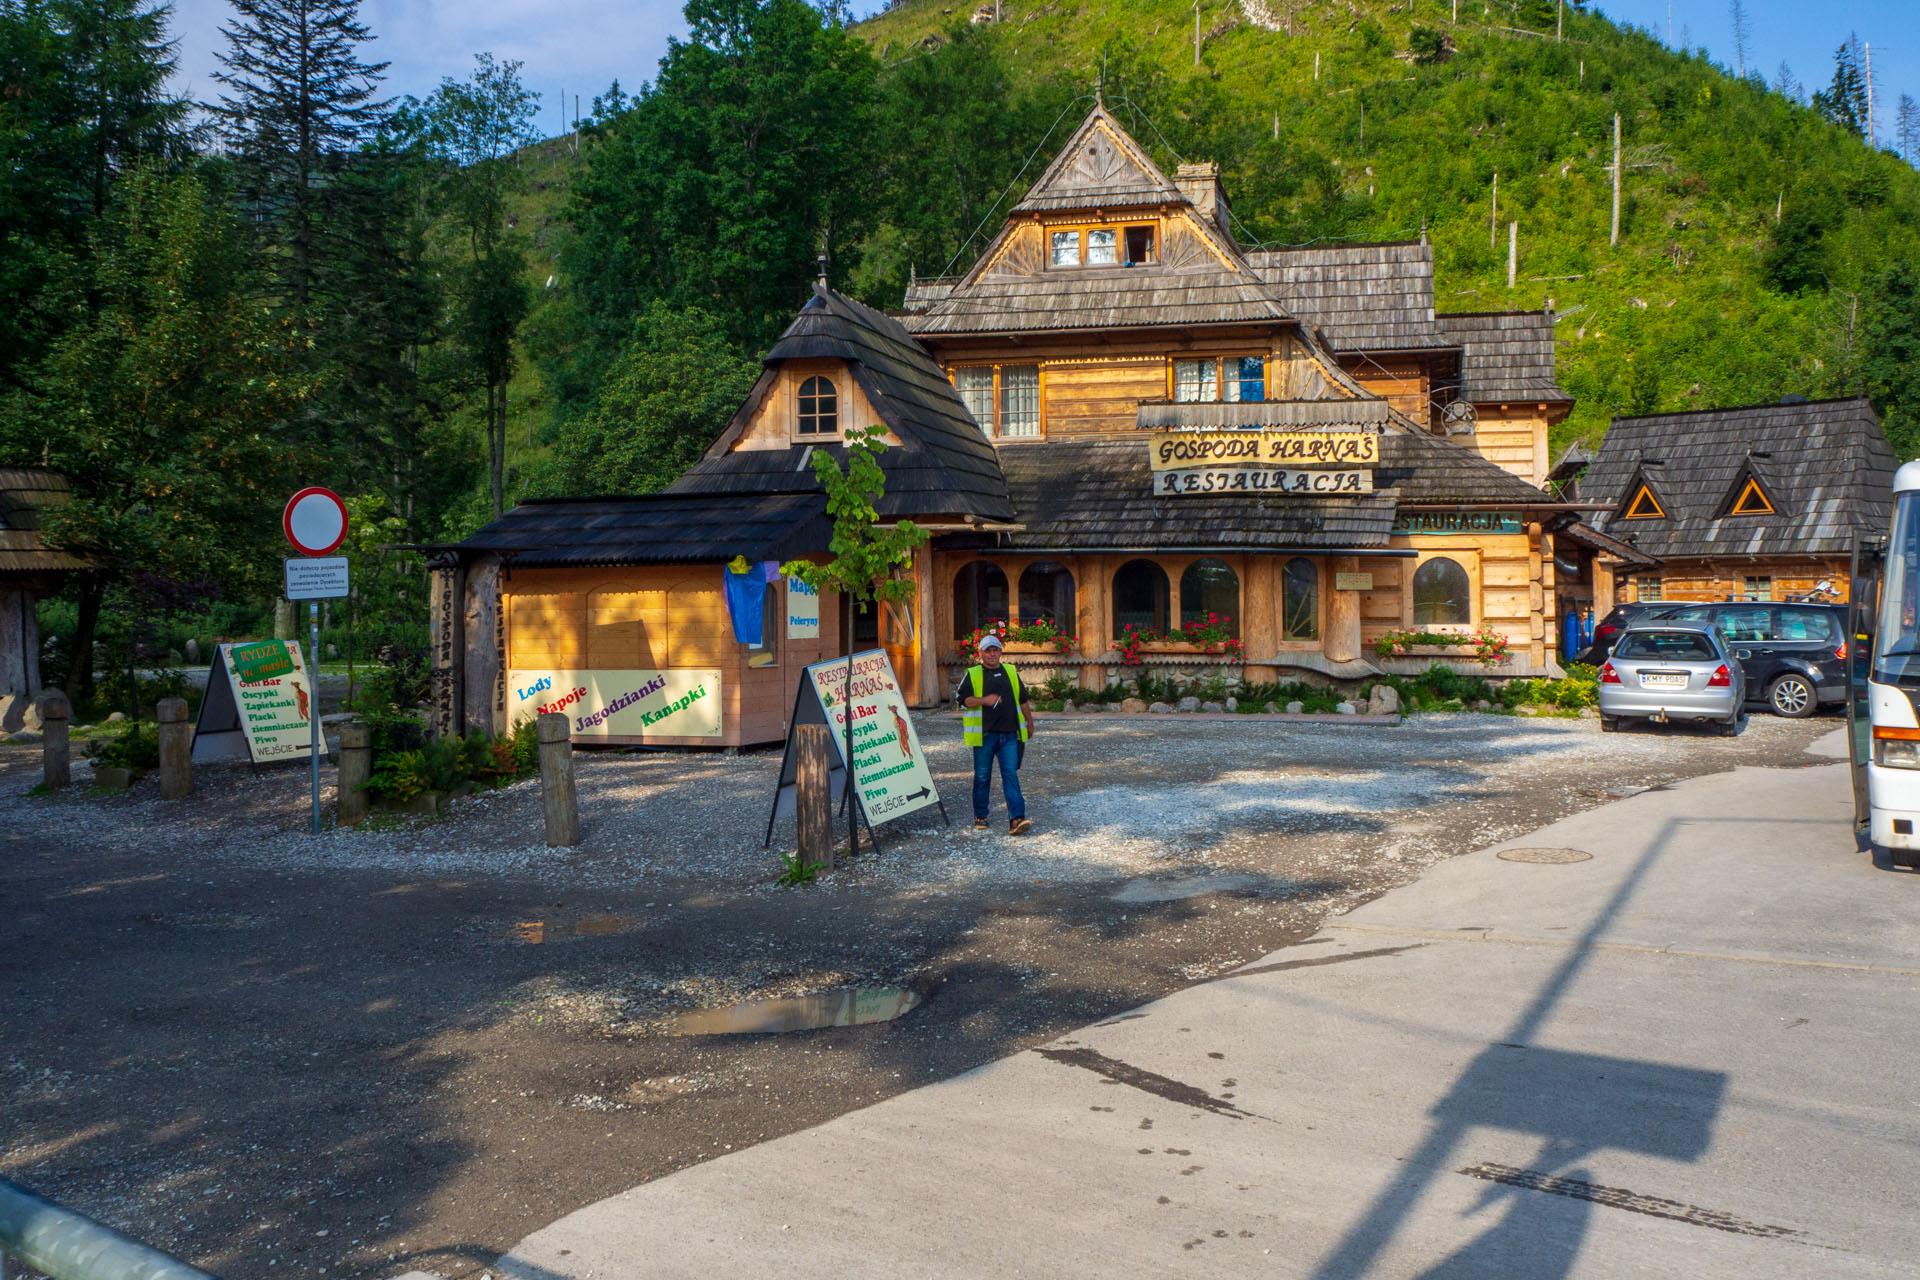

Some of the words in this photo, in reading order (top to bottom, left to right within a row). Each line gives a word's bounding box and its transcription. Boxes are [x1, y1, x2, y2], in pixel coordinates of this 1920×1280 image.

[1159, 439, 1260, 463] GOSPODA
[1269, 437, 1374, 462] HARNAŚ
[1163, 471, 1362, 493] RESTAURACJA
[790, 615, 818, 627] Peleryny
[240, 644, 281, 663] RYDZE
[262, 678, 281, 687] Bar
[517, 676, 552, 701] Lody
[242, 689, 278, 699] Oscypki
[536, 686, 587, 714] Napoje
[576, 674, 667, 732] Jagodzianki
[244, 699, 295, 710] Zapiekanki
[640, 684, 707, 728] Kanapki
[856, 705, 877, 718] Bar
[248, 712, 277, 722] Placki
[252, 721, 309, 733] ziemniaczane
[842, 720, 878, 739] Ocypki
[254, 736, 277, 744] Piwo
[852, 731, 897, 753] apiekanki
[257, 744, 294, 756] WEJŚCIE
[853, 753, 882, 770] Placki
[859, 760, 915, 786] ziemniaczane
[864, 786, 888, 801] Piwo
[869, 795, 906, 817] WEJŚCIE
